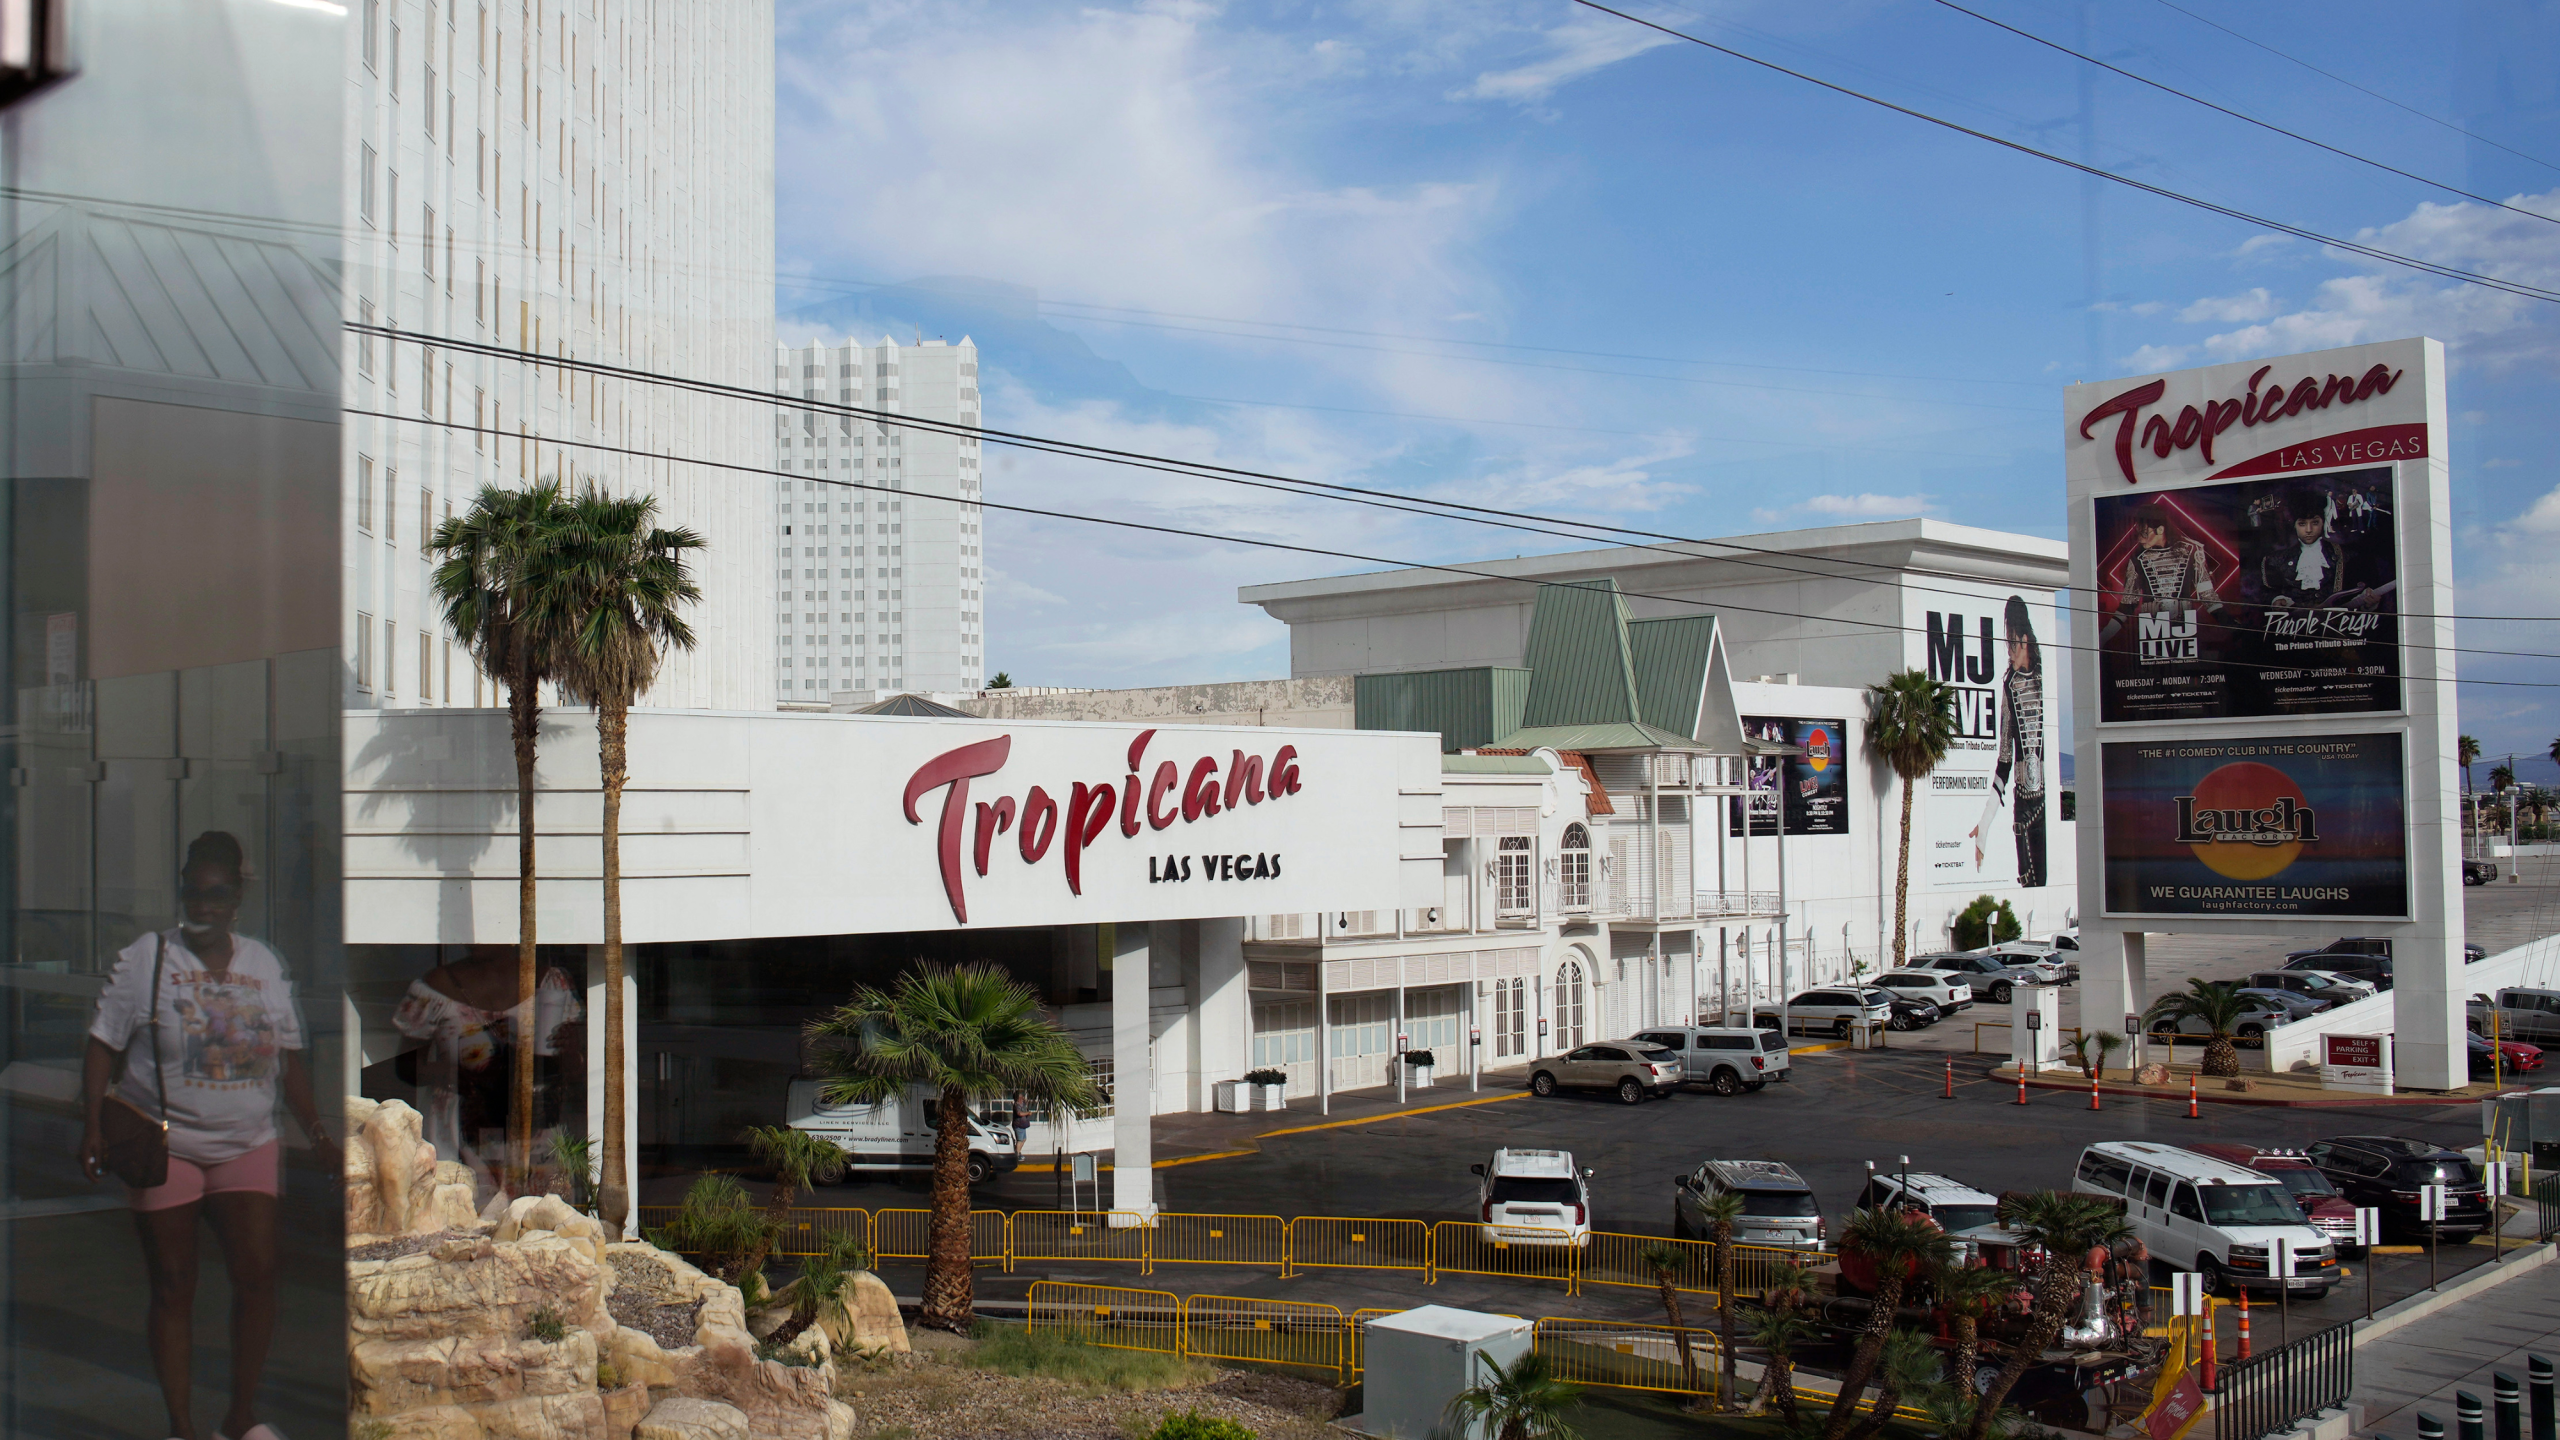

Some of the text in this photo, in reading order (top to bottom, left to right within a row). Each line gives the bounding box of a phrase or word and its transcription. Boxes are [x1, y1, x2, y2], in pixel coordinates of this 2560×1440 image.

[2080, 364, 2402, 484] Tropicana
[2280, 436, 2421, 468] LAS VEGAS
[2138, 610, 2198, 640] MJ
[2263, 608, 2379, 642] Purple Reign
[1926, 610, 1994, 684] MJ
[2142, 639, 2195, 659] LIVE
[2275, 643, 2288, 651] The
[2290, 642, 2313, 650] Prince
[2314, 640, 2341, 648] Tribute
[2116, 678, 2154, 688] WEDNESDAY
[2162, 676, 2191, 686] MONDAY
[2200, 675, 2226, 684] 7:30PM
[2260, 670, 2302, 680] WEDNESDAY
[2311, 668, 2347, 677] SATURDAY
[2358, 666, 2386, 675] 9:30PM
[1805, 740, 1831, 758] Laugh
[1966, 741, 1980, 750] Tribute
[1981, 742, 1997, 751] Concert
[2165, 749, 2176, 757] #1
[2179, 747, 2224, 757] COMEDY
[2227, 746, 2256, 756] CLUB
[2259, 746, 2270, 754] IN
[2273, 746, 2293, 754] THE
[1932, 776, 1988, 790] PERFORMING NIGHTLY
[902, 729, 1302, 924] Tropicana
[2173, 796, 2319, 845] Laugh
[1149, 853, 1281, 883] LAS VEGAS
[2150, 886, 2350, 900] WE GUARANTEE LAUGHS
[2202, 901, 2298, 910] laughfactory.com
[2341, 1071, 2367, 1079] Tropicana
